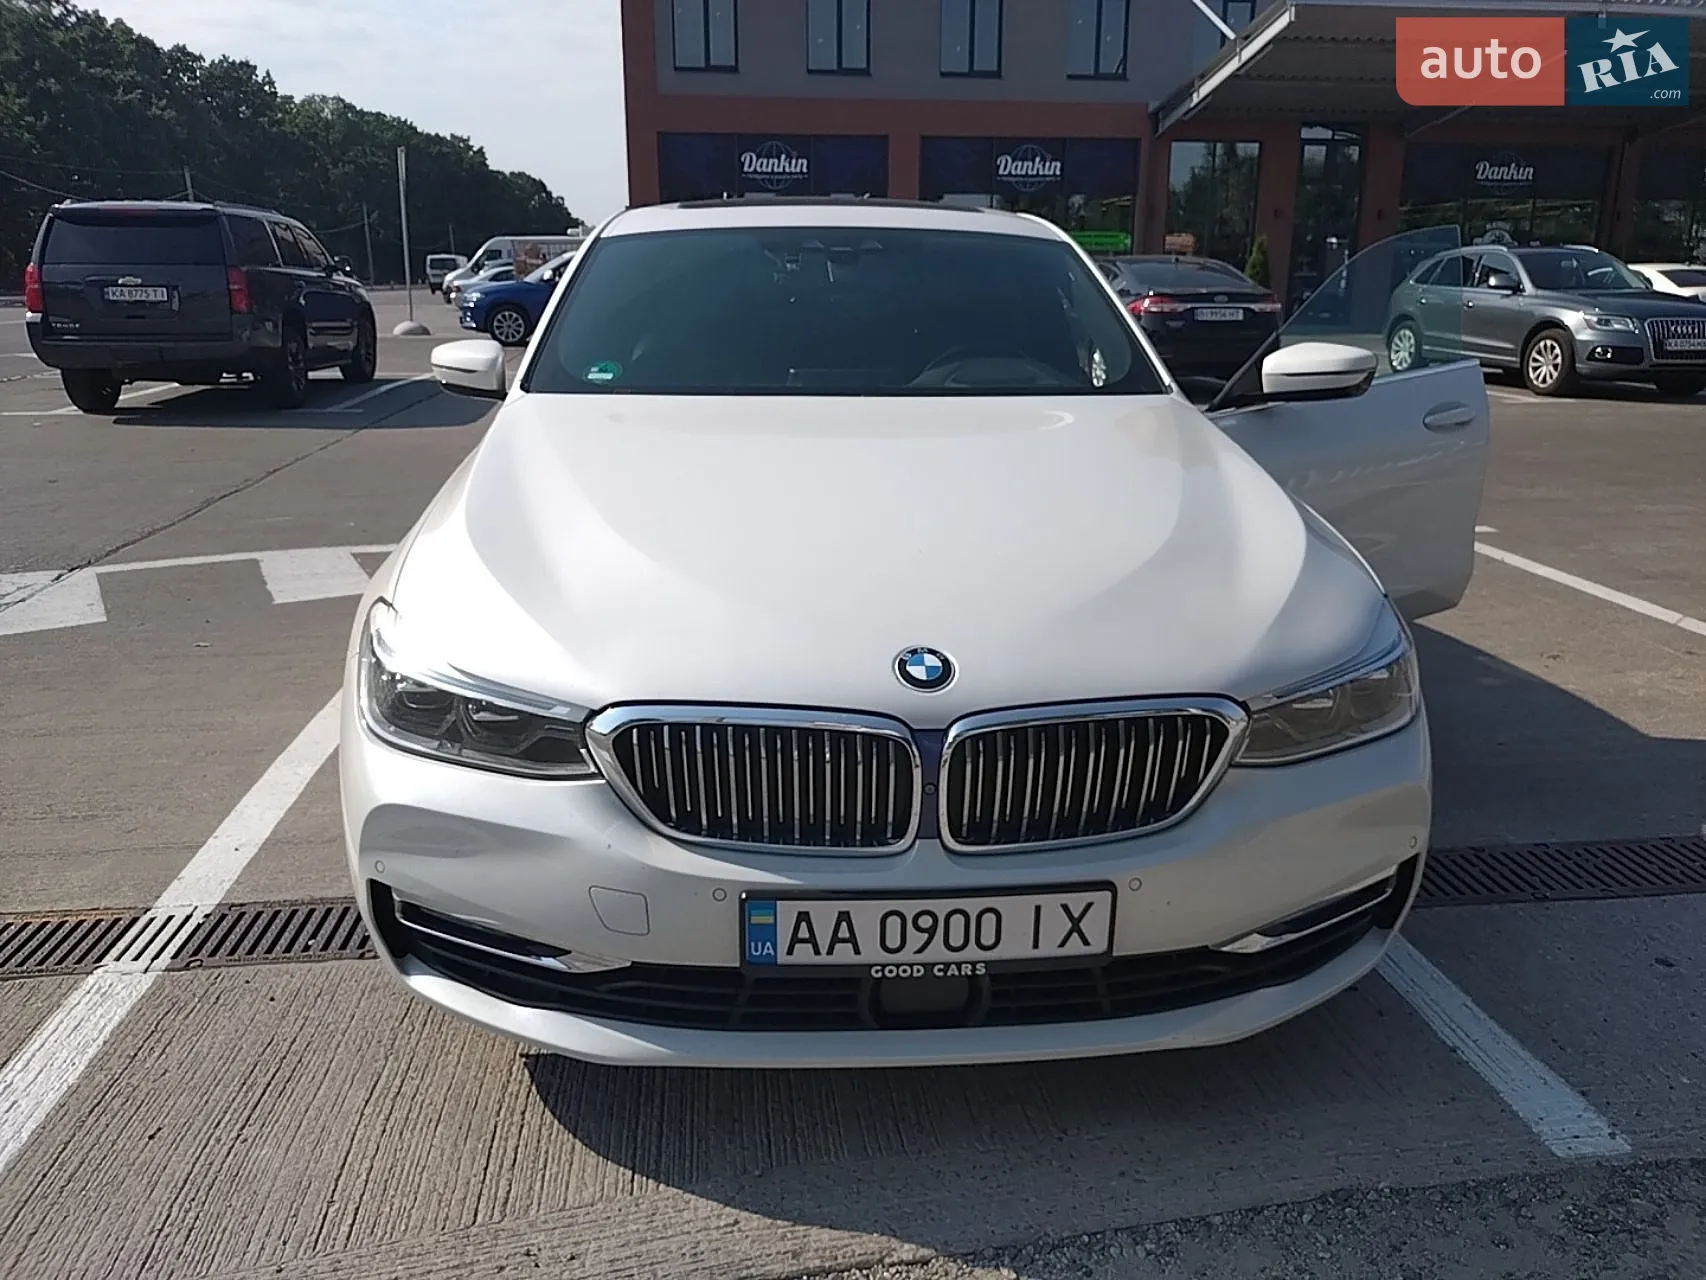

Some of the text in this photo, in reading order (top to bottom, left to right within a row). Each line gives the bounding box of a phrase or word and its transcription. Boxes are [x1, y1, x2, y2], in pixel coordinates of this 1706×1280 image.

[741, 151, 808, 174] Dankin
[996, 154, 1061, 176] Dankin
[1475, 160, 1534, 180] Dankin
[786, 910, 861, 956] AA
[879, 907, 1002, 955] 0900
[750, 943, 774, 956] UA
[870, 963, 986, 978] GOOD CARS
